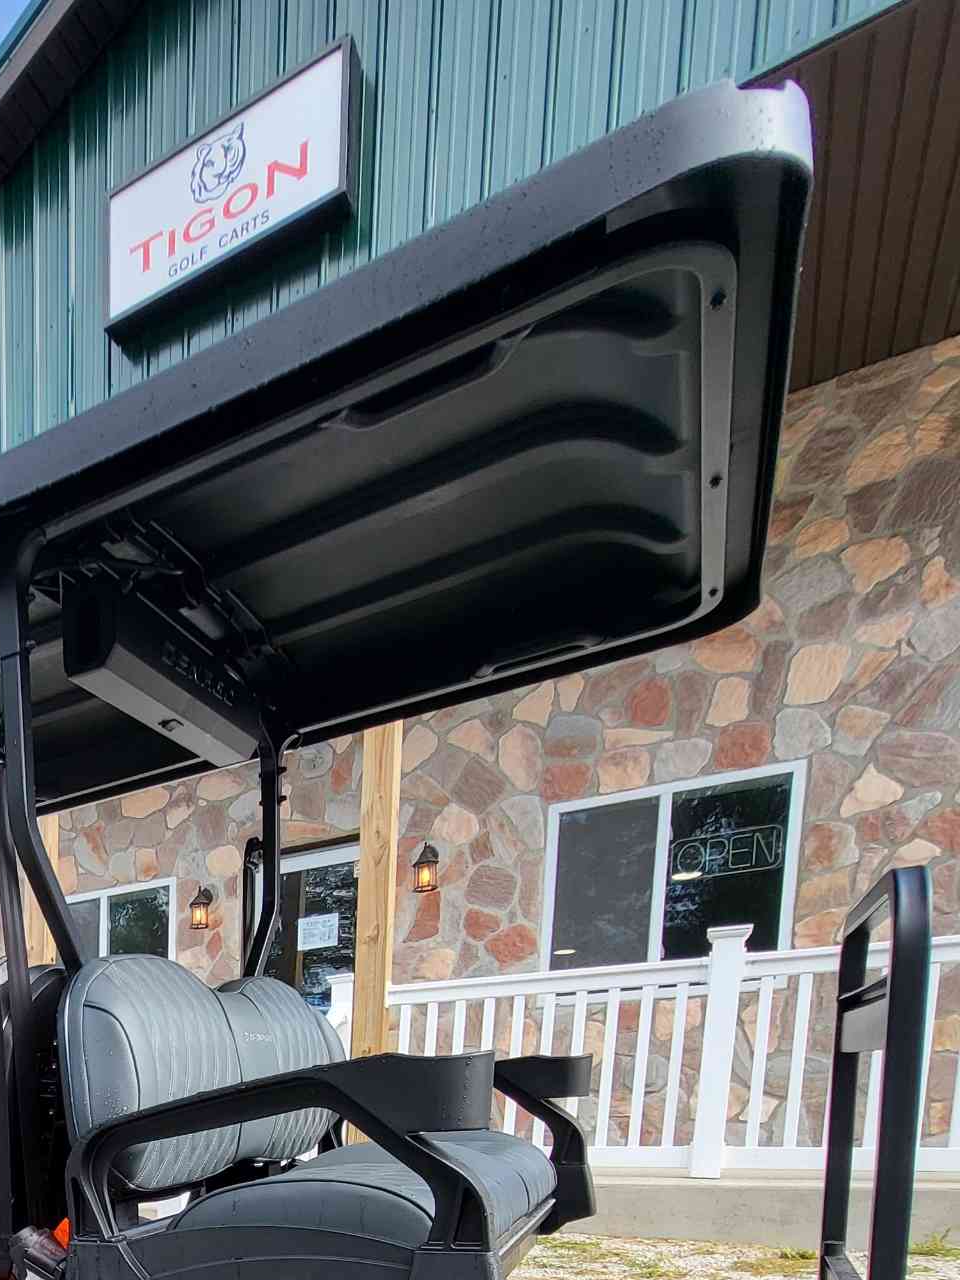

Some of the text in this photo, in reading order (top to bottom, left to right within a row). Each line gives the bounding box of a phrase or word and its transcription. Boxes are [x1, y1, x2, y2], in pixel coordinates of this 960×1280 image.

[129, 137, 311, 273] TIGON
[168, 209, 271, 278] GOLF CARTS
[676, 829, 777, 874] OPEN
